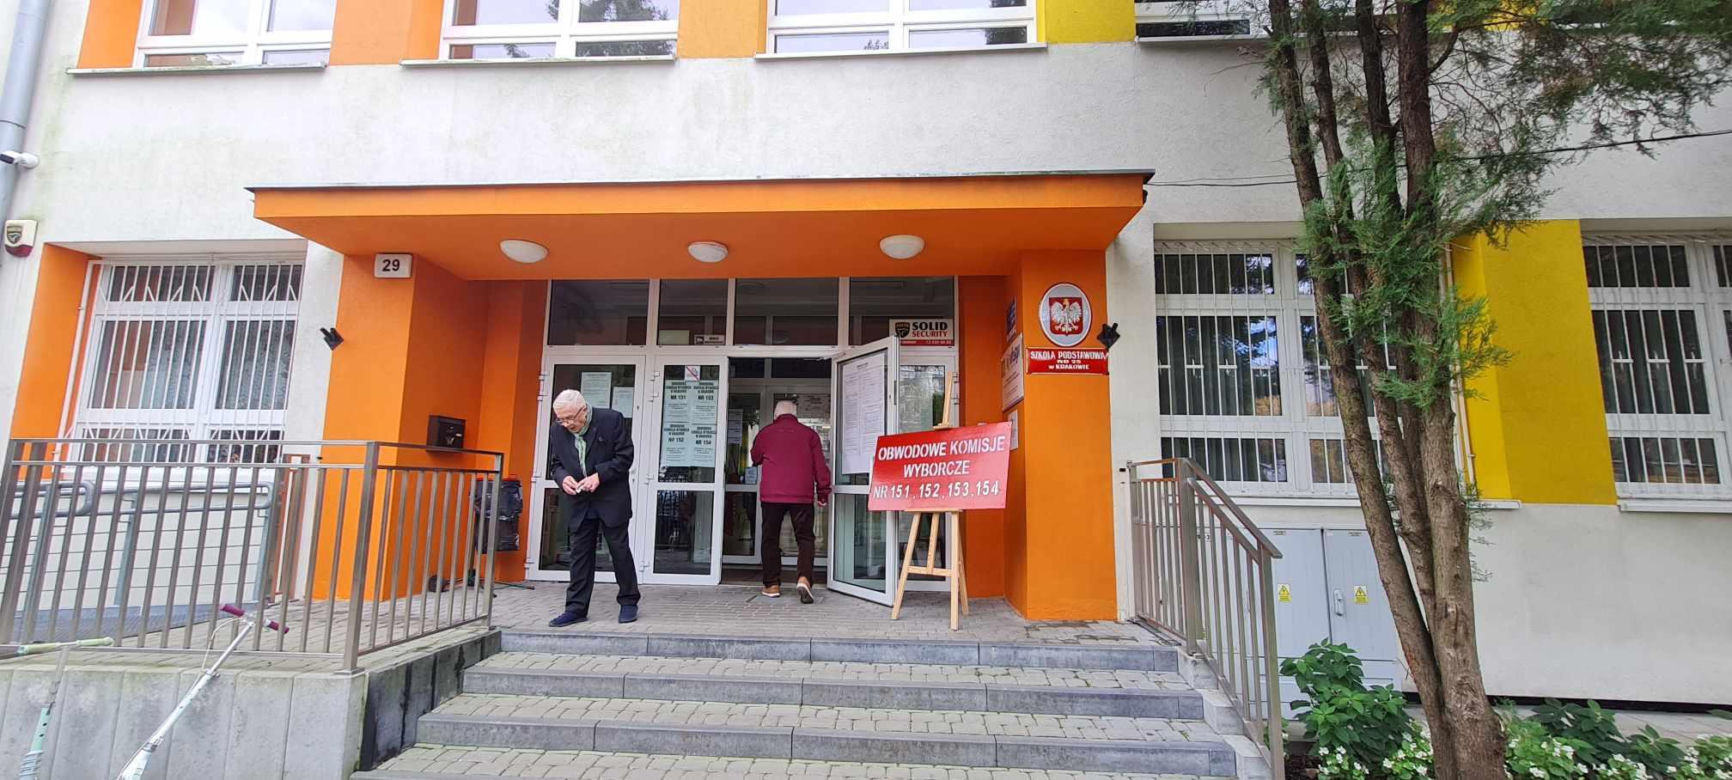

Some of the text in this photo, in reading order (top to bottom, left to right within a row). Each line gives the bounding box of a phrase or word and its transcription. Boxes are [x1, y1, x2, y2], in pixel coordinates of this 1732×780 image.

[382, 259, 400, 271] 29
[912, 321, 948, 331] SOLID
[1058, 351, 1106, 360] PODSTAWOWA
[878, 436, 1005, 461] OBWODOWE KOMISJE
[903, 460, 970, 478] WYBORCZE
[873, 485, 888, 498] NR
[976, 480, 999, 496] 154
